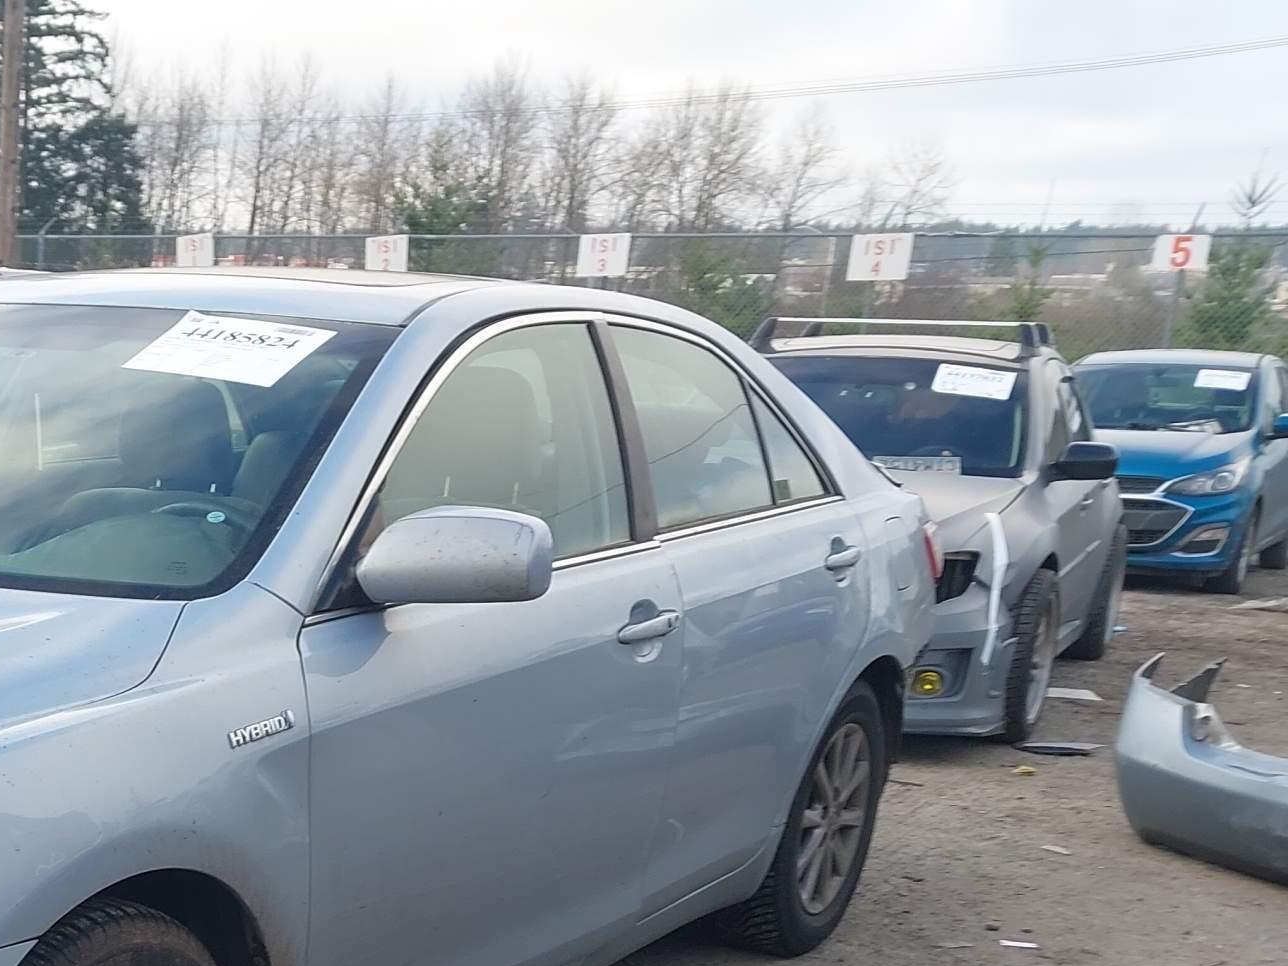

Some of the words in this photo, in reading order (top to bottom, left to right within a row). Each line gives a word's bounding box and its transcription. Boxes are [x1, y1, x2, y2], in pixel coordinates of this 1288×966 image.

[1171, 235, 1193, 268] 5
[597, 257, 608, 273] 3
[870, 260, 882, 277] 4
[181, 327, 301, 349] 44185824
[228, 716, 287, 748] HYBRID
